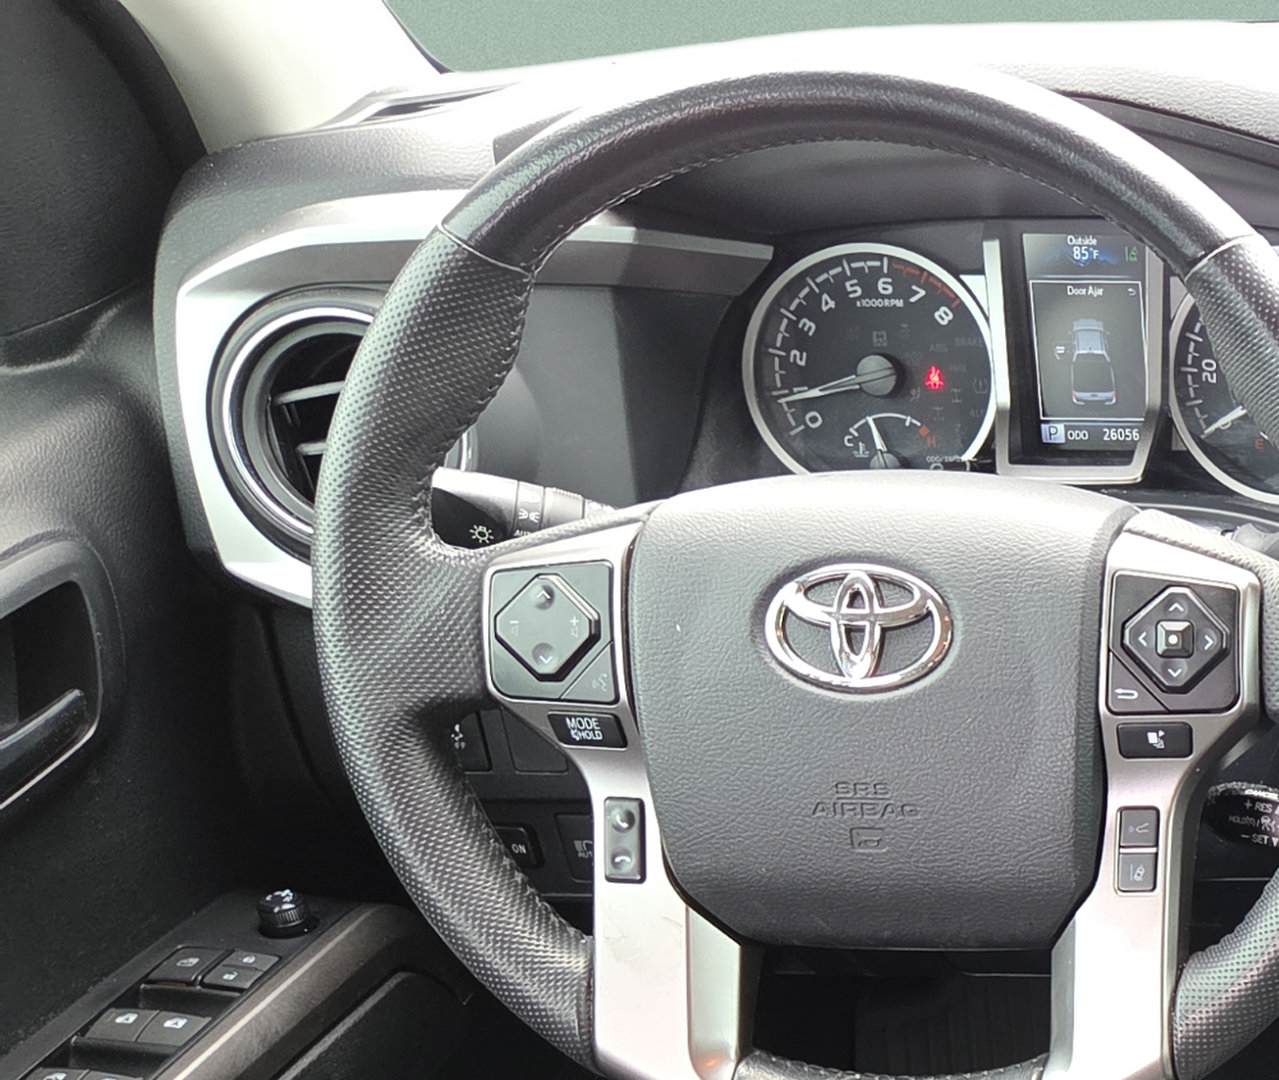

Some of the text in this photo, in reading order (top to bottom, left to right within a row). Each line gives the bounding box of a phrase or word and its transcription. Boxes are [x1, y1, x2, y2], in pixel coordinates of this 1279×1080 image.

[1067, 235, 1097, 246] Outside
[845, 279, 862, 298] 5
[877, 277, 893, 295] 6
[909, 285, 927, 303] 7
[1067, 285, 1104, 297] Door Ajar
[821, 293, 836, 312] 4
[933, 306, 954, 326] 8
[798, 317, 817, 336] 3
[790, 349, 807, 367] 2
[1202, 358, 1217, 384] 20
[805, 411, 823, 429] 0
[1048, 425, 1059, 441] P
[1067, 428, 1140, 441] ODO 26056
[566, 716, 600, 730] MODE
[578, 730, 603, 740] HOLD
[834, 781, 890, 797] SRS
[811, 801, 921, 820] AIRBAG
[1254, 801, 1273, 814] RES
[1251, 833, 1270, 845] SET
